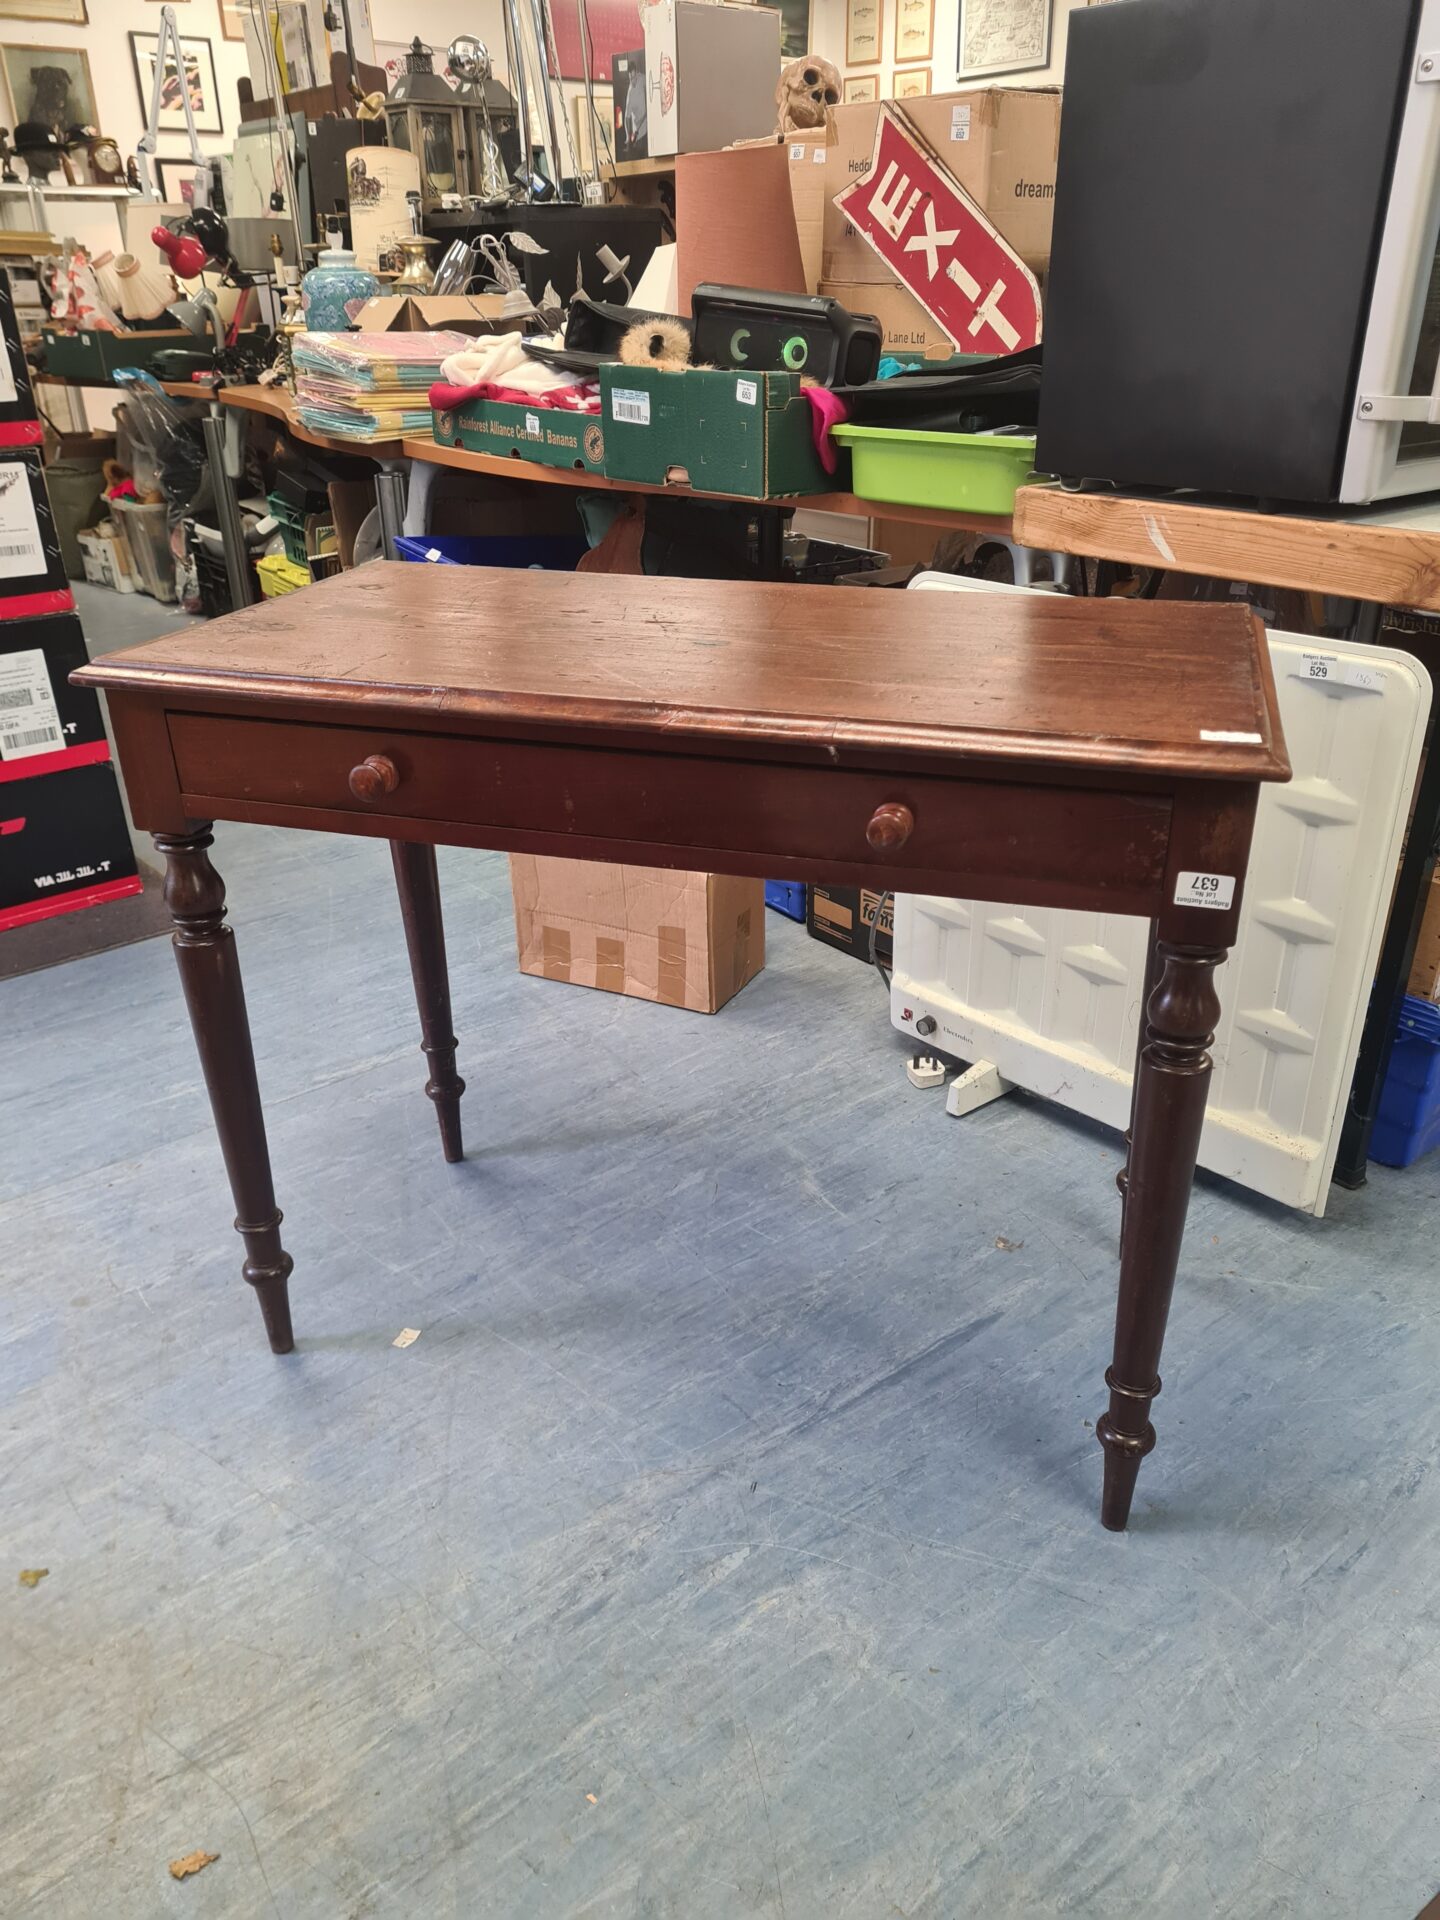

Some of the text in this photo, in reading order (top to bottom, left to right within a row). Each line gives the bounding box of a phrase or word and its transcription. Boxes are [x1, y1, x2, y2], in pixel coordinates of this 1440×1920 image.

[867, 160, 1021, 351] EXIT
[888, 331, 908, 344] Lane
[911, 332, 925, 344] Ltd
[742, 391, 752, 400] 653
[458, 415, 489, 433] Rainforest
[490, 421, 515, 438] Alliance
[547, 429, 578, 448] Bananas
[1309, 665, 1328, 678] 529
[1191, 876, 1219, 892] 637
[1176, 896, 1230, 908] Badgers Auctions
